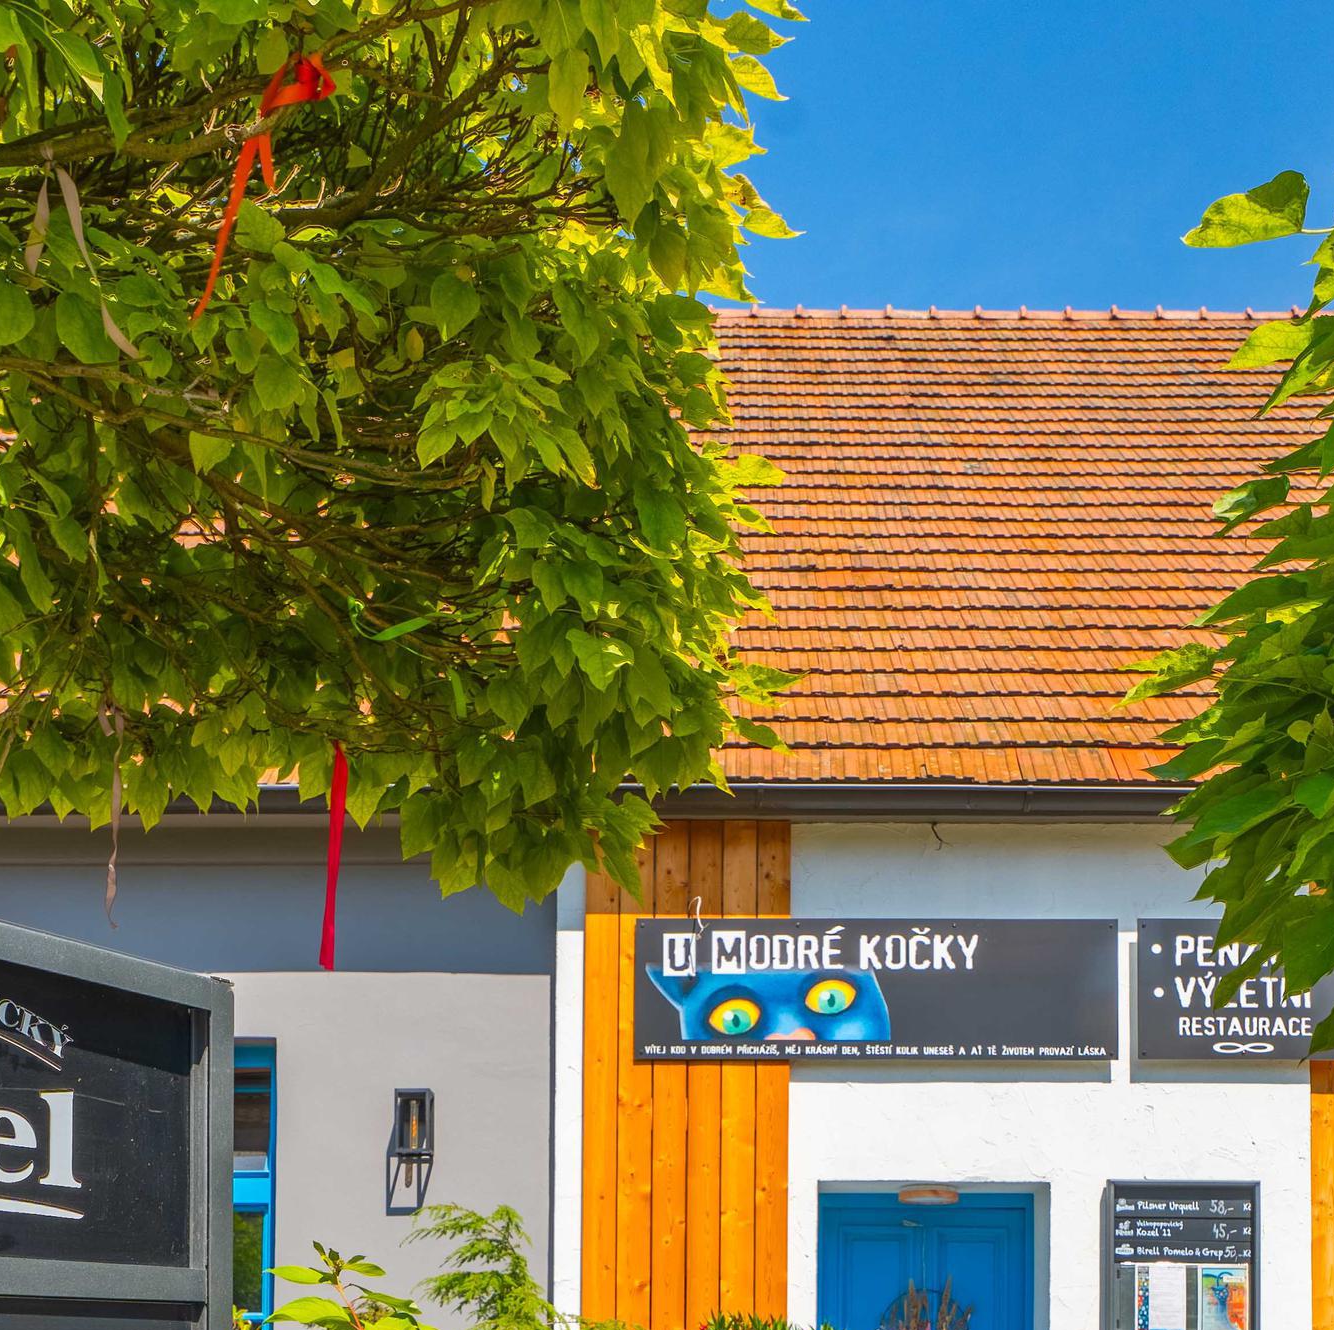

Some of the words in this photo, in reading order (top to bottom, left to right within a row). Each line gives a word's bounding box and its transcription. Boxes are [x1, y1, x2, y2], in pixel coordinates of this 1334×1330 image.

[664, 934, 695, 975] U
[713, 925, 846, 973] MODRÉ
[859, 927, 979, 970] KOČKY
[1178, 1016, 1313, 1036] RESTAURACE
[645, 1043, 666, 1055] VÍTEJ
[690, 1045, 697, 1055] V
[896, 1045, 919, 1055] KOLIK
[958, 1046, 966, 1056] A
[1078, 1045, 1107, 1056] LÁSKA
[1137, 1200, 1166, 1211] Pilsner
[1169, 1200, 1200, 1214] Urquell
[1136, 1227, 1159, 1237] Kozel
[1163, 1228, 1172, 1237] 11
[1137, 1246, 1160, 1255] Birell
[1163, 1246, 1193, 1256] Pomelo
[1201, 1247, 1223, 1261] Grep
